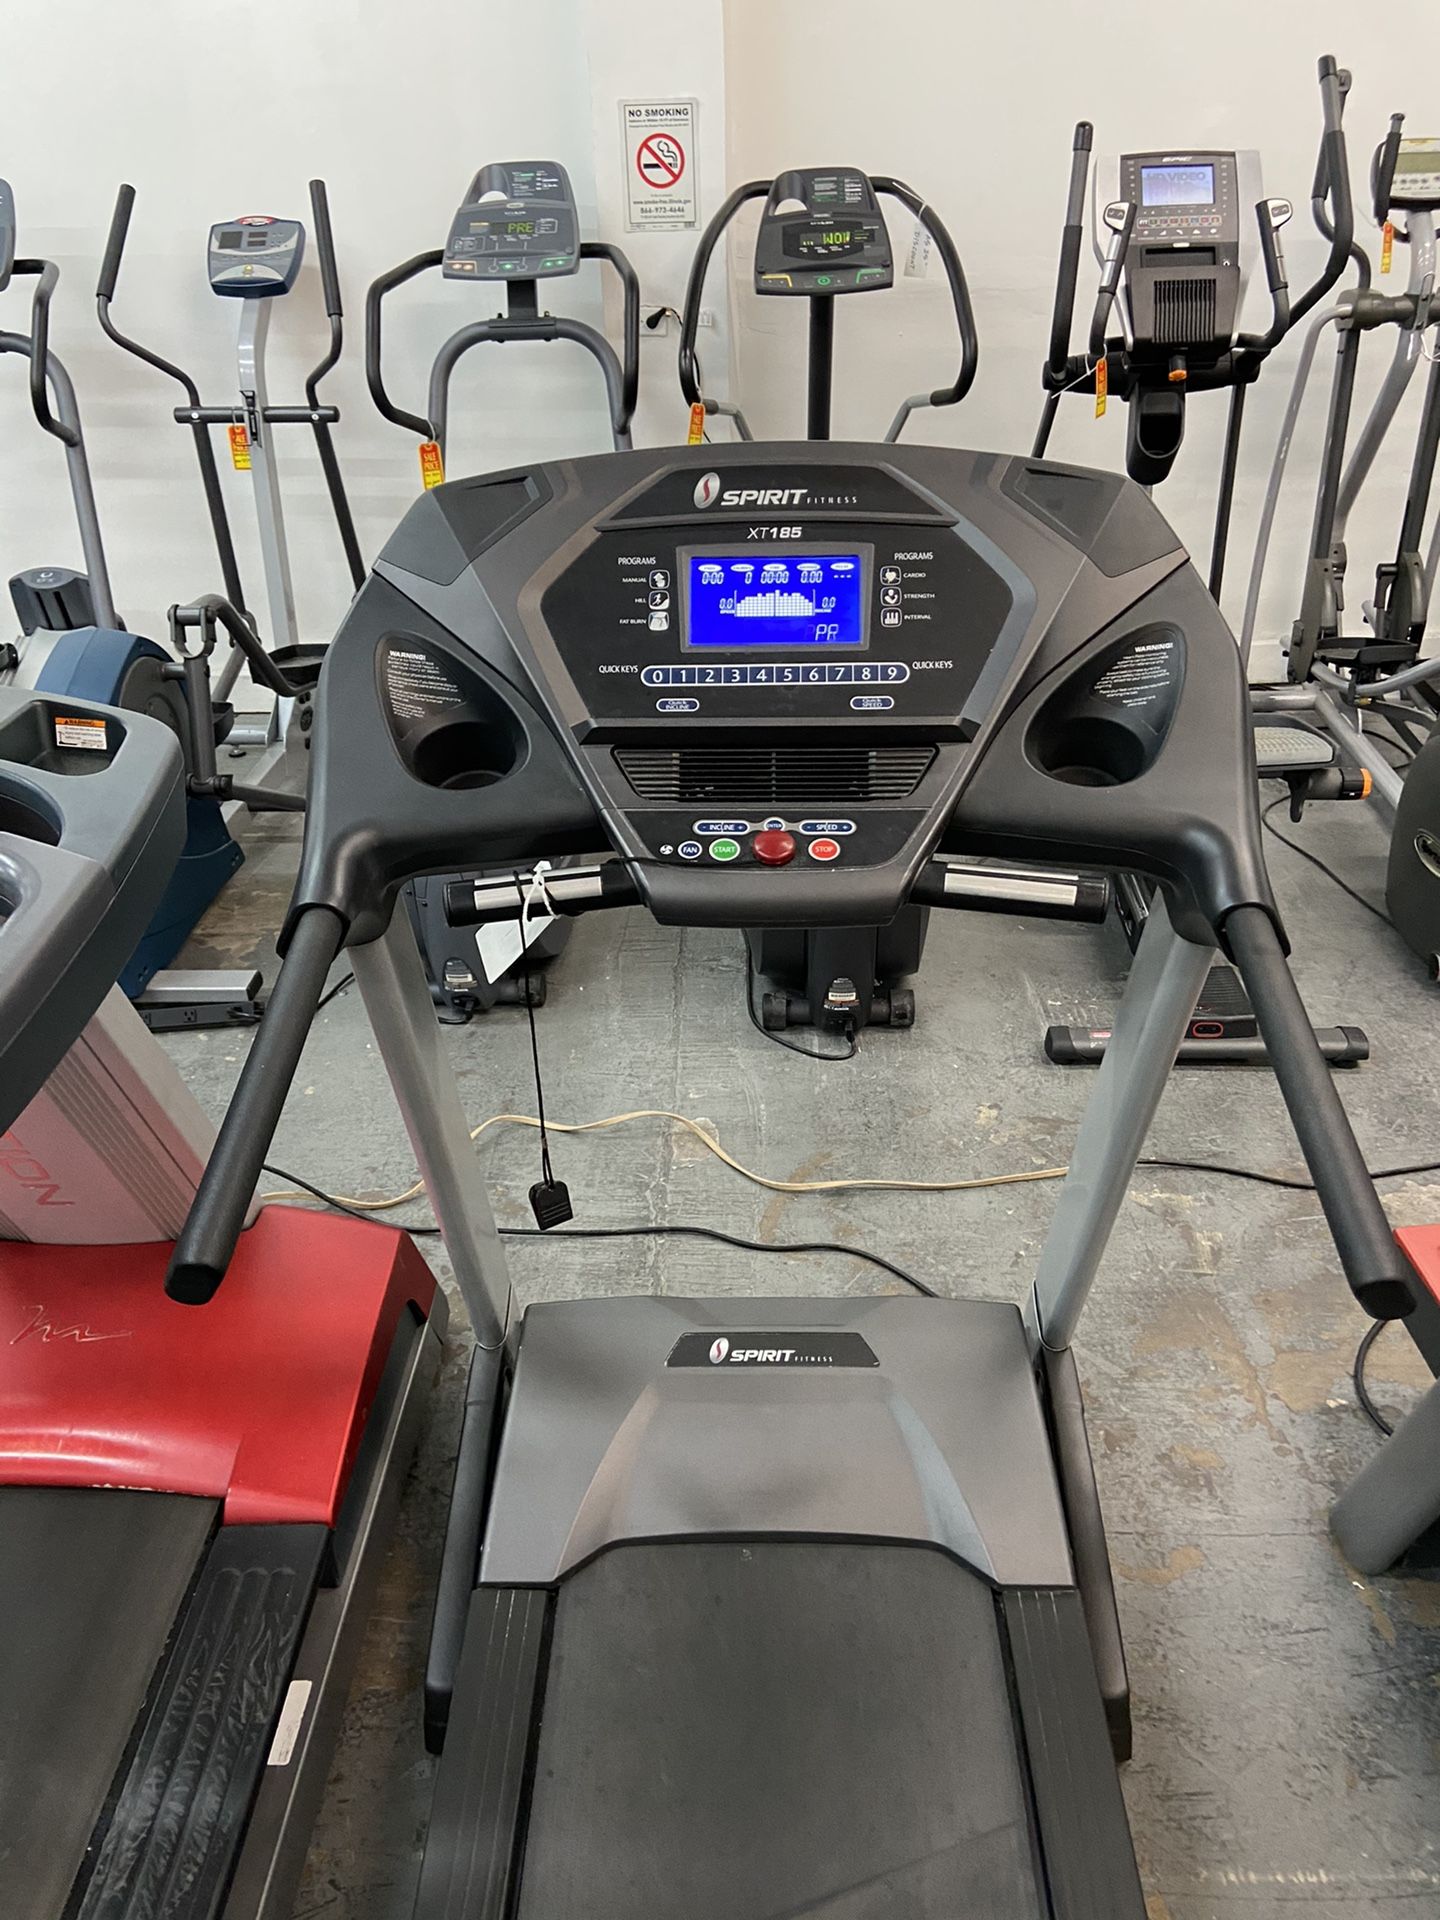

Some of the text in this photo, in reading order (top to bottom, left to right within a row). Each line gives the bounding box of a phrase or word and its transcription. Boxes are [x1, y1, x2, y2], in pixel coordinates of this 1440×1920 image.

[628, 108, 689, 118] NO SMOKING
[507, 222, 534, 234] PRE
[720, 489, 857, 506] SPIRIT FITNESS
[747, 527, 802, 539] XT185
[618, 557, 656, 566] PROGRAMS
[894, 552, 933, 560] PROGRAMS
[744, 572, 752, 584] 0
[1134, 642, 1174, 652] WARNING!
[390, 650, 426, 660] WARNING!
[599, 665, 638, 674] QUICK KEYS
[912, 661, 953, 670] QUICK KEYS
[652, 670, 662, 682] 0
[680, 670, 686, 682] 1
[706, 670, 714, 682] 2
[731, 669, 740, 682] 3
[756, 669, 767, 682] 4
[784, 668, 792, 681] 5
[809, 668, 818, 680] 6
[835, 668, 844, 680] 7
[862, 667, 870, 680] 8
[888, 666, 897, 679] 9
[730, 1350, 796, 1362] SPIRIT
